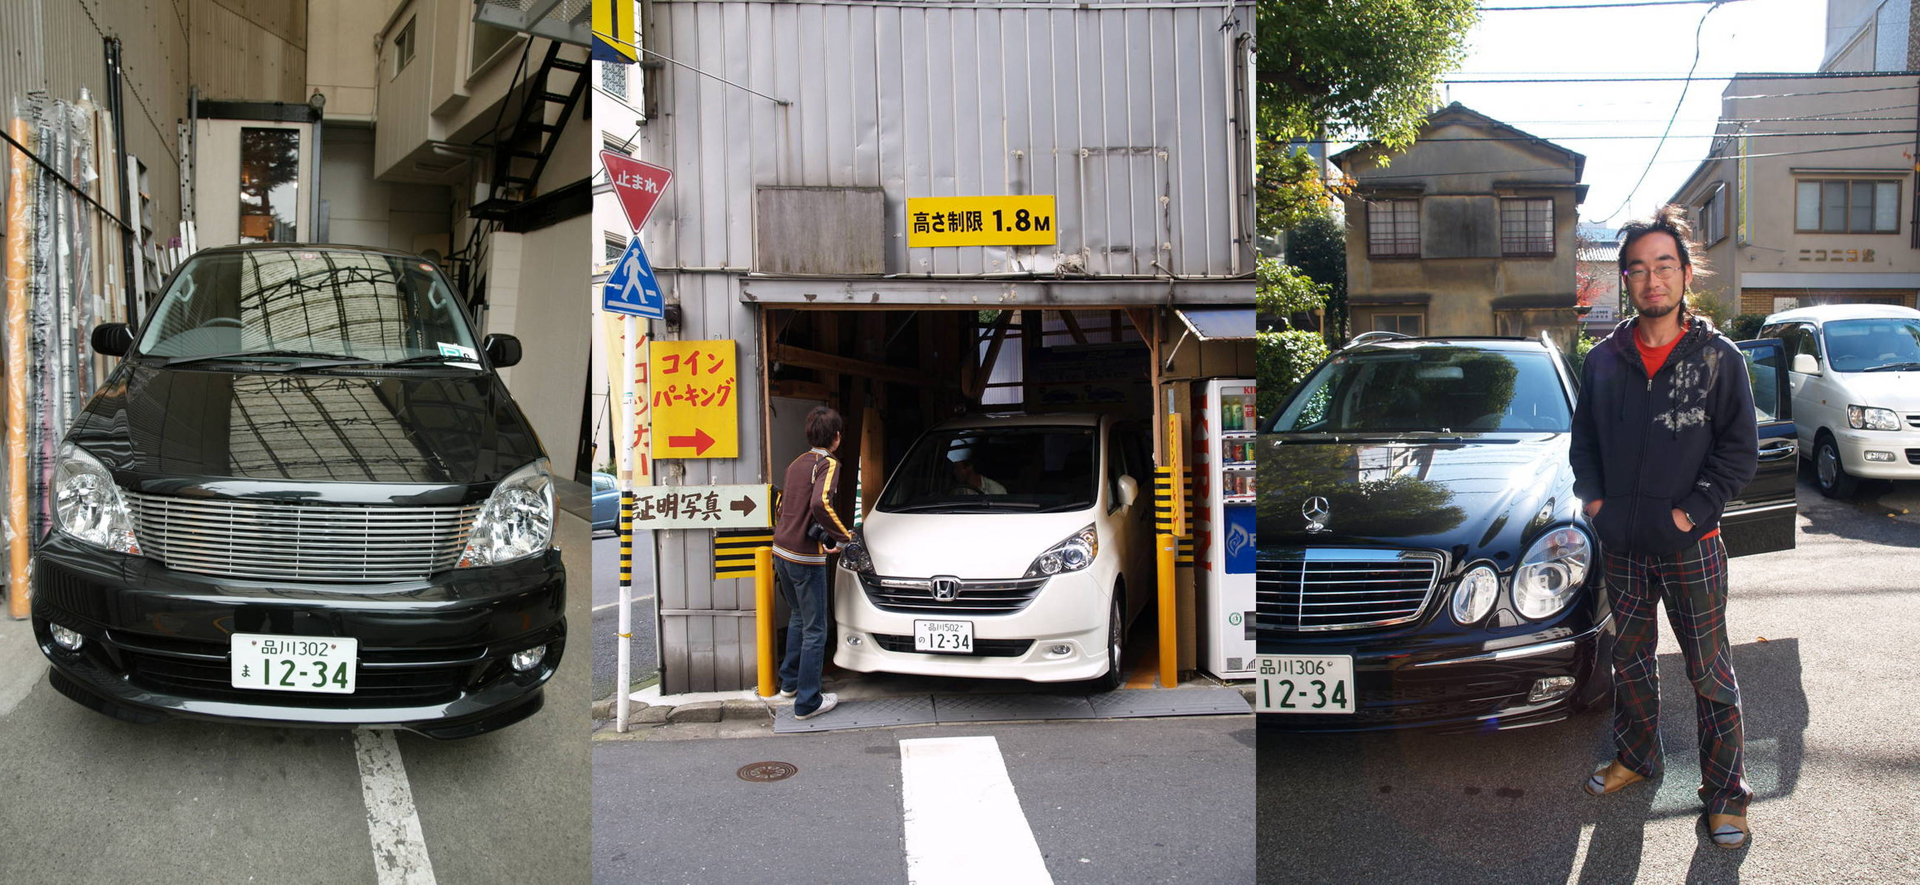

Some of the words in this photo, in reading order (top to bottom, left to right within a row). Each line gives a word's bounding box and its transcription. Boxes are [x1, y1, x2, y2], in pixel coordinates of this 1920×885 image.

[616, 170, 658, 194] 止まれ
[913, 211, 983, 234] 高さ制限
[992, 209, 1050, 232] 1.8M
[662, 350, 724, 376] コイン
[653, 377, 735, 407] パーキング
[1192, 392, 1212, 572] KIRIN
[632, 491, 722, 521] 証明写真
[928, 623, 959, 632] 品川502
[261, 640, 329, 657] 品川302
[918, 636, 926, 644] の
[930, 633, 969, 649] 12-34
[241, 664, 251, 678] ま
[264, 658, 348, 689] 12-34
[1260, 660, 1325, 675] 品川306
[1263, 679, 1347, 710] 12-34
